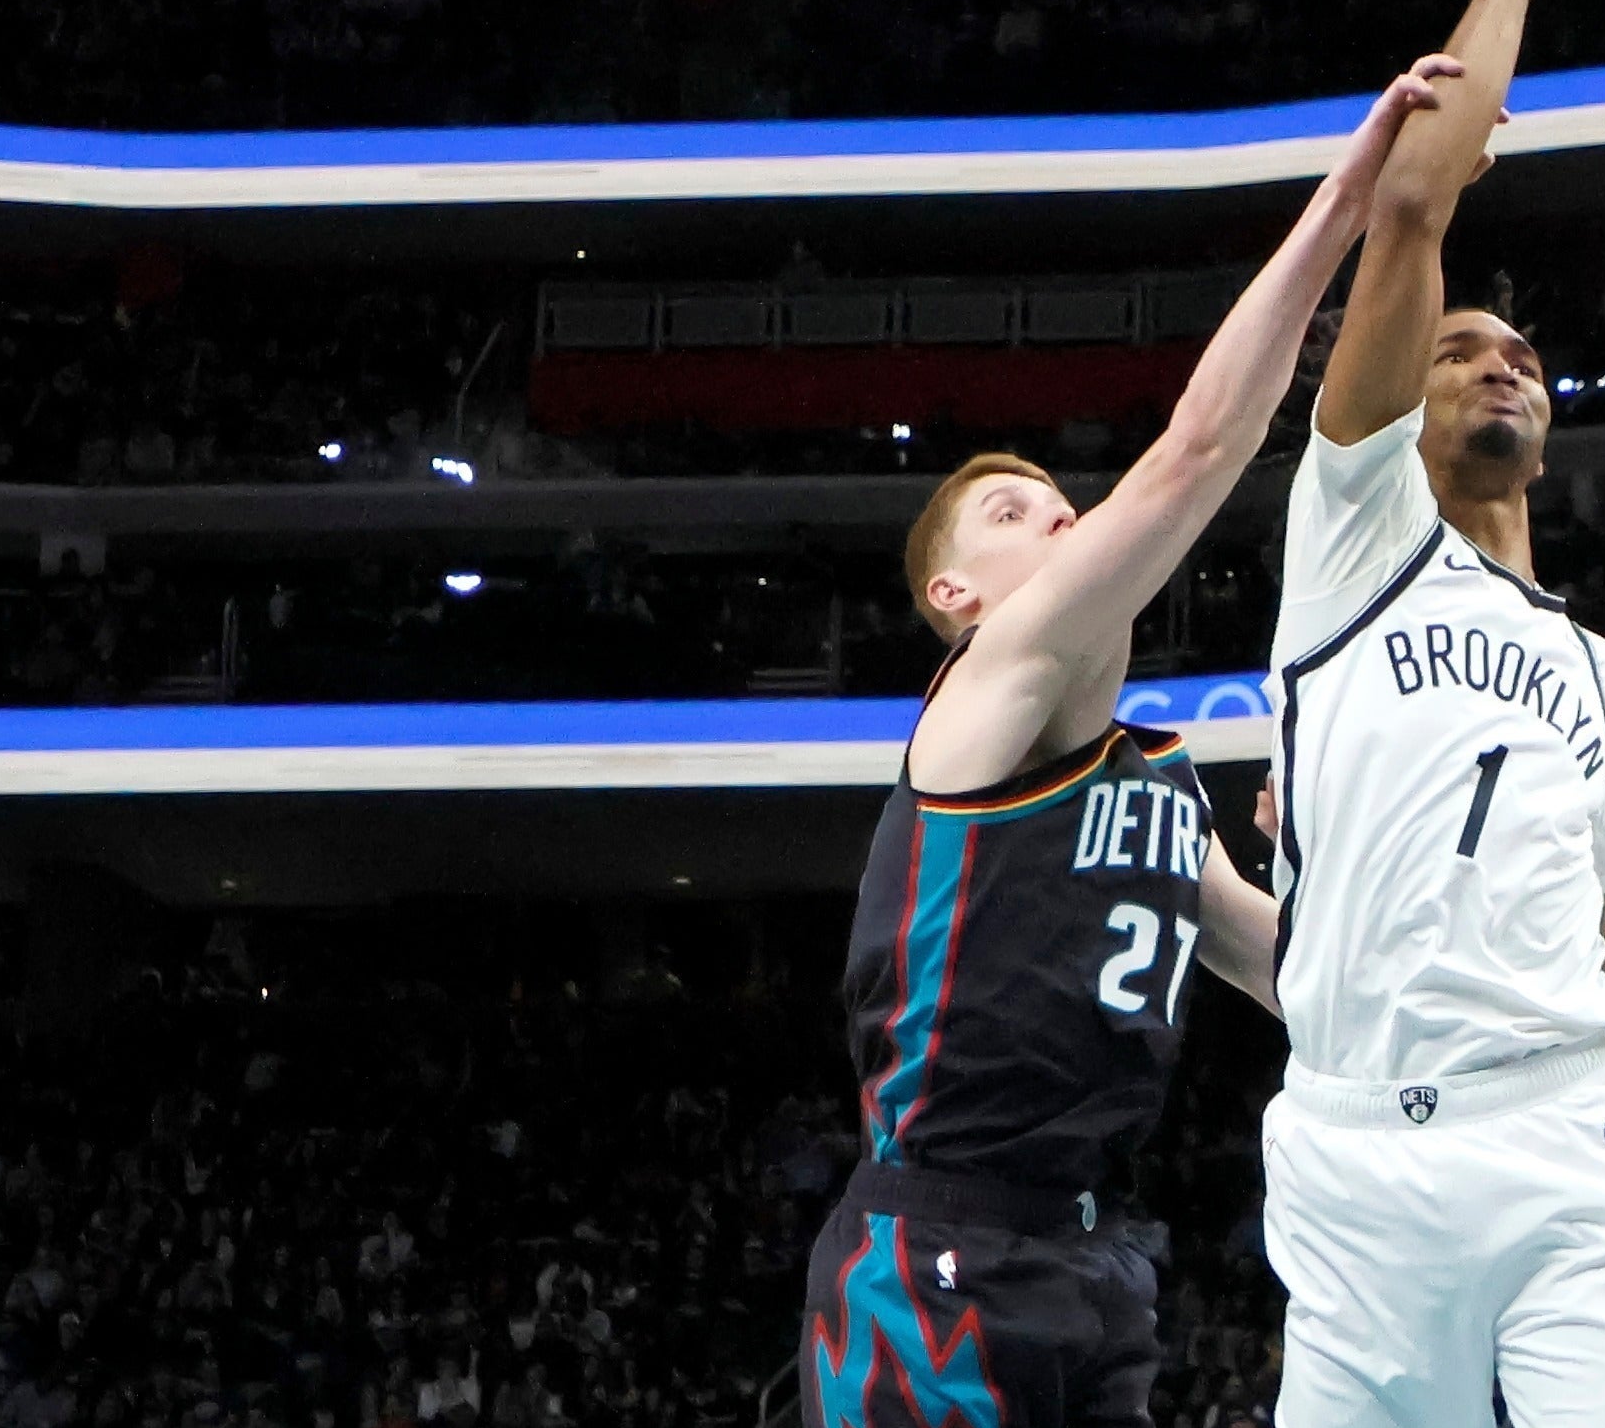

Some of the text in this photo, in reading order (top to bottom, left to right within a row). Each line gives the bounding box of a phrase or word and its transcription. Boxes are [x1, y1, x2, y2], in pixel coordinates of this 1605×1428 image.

[1384, 623, 1605, 781] BROOKLYN
[1072, 779, 1209, 882] DETR
[1455, 743, 1510, 859] 1
[1402, 1088, 1436, 1105] NETS
